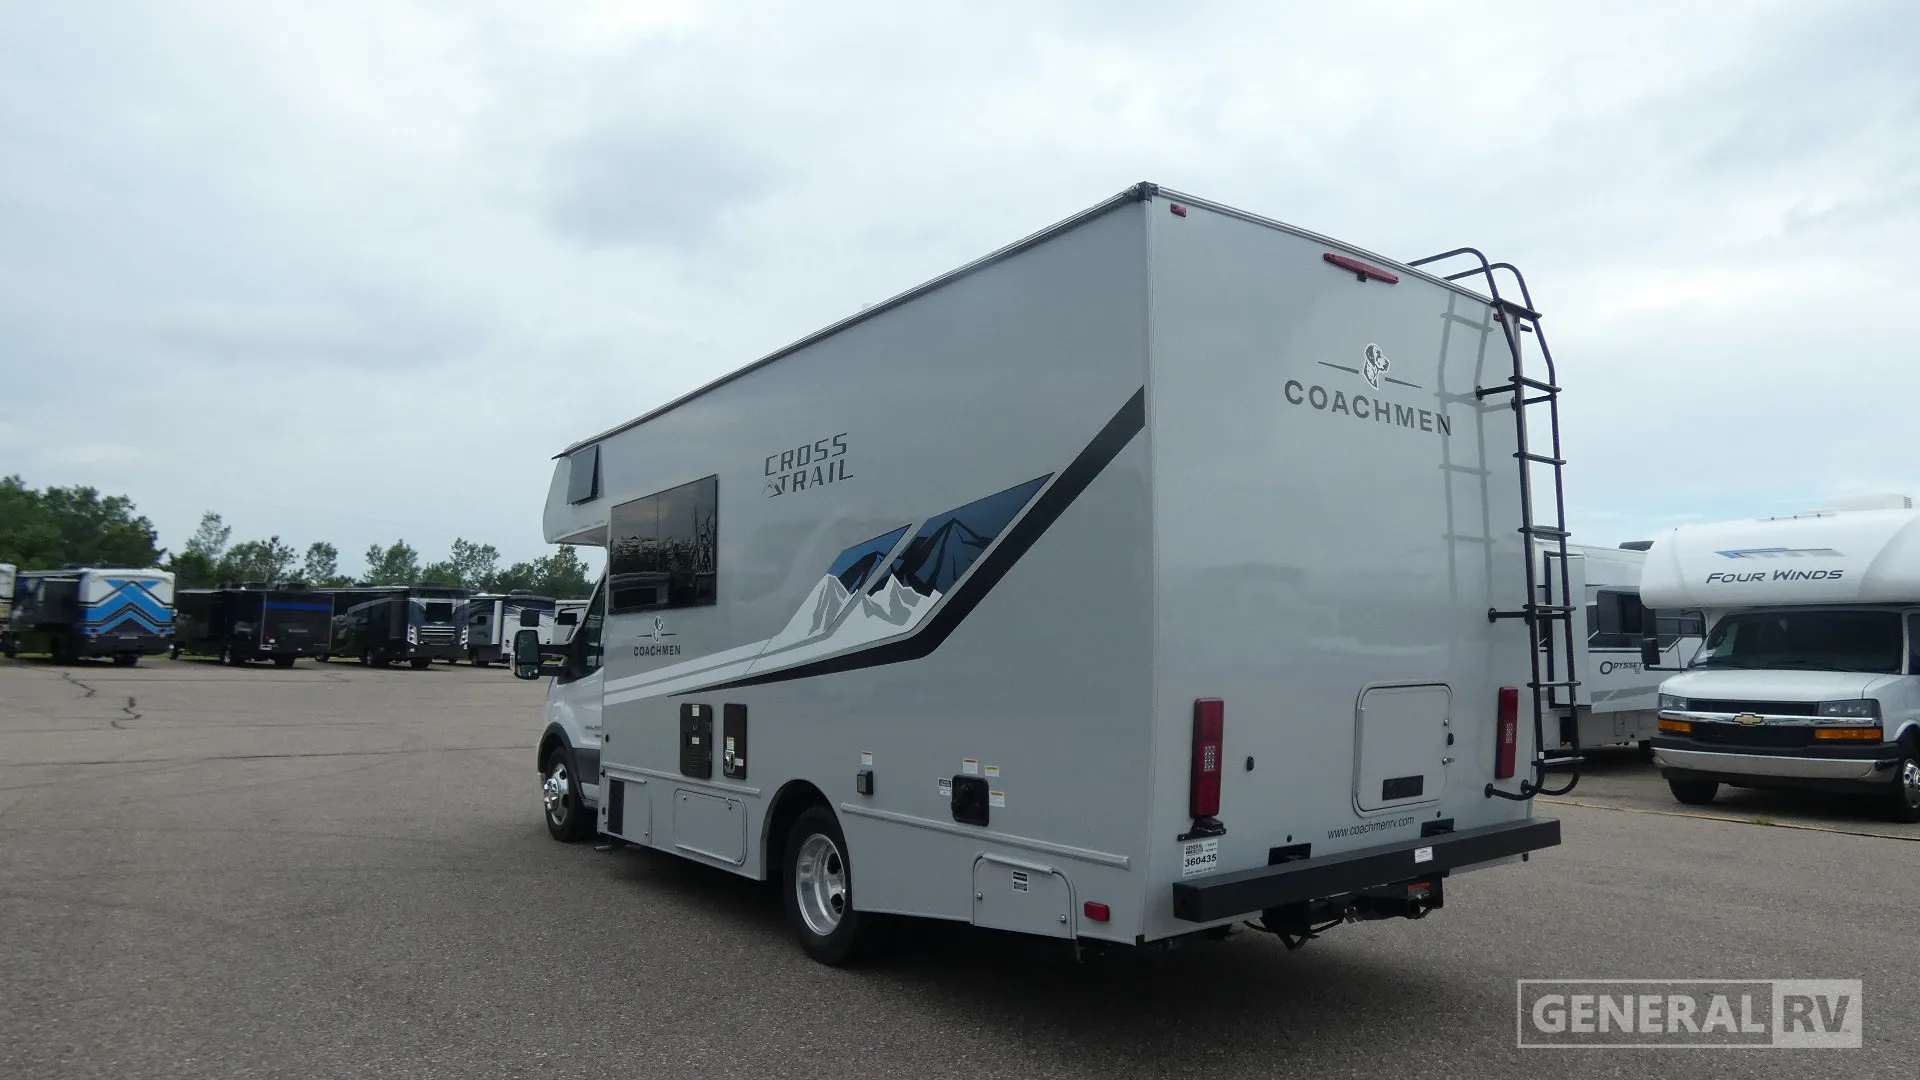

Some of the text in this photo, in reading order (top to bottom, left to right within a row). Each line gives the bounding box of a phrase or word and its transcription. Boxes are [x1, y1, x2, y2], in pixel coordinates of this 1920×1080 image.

[1284, 379, 1452, 436] COACHMEN
[764, 432, 848, 476] CROSS
[777, 458, 854, 493] TRAIL
[1705, 569, 1844, 584] FOUR WINDS
[633, 645, 681, 656] COACHMEN
[1327, 816, 1415, 839] www.coachmenrv.com
[1184, 853, 1217, 868] 360435
